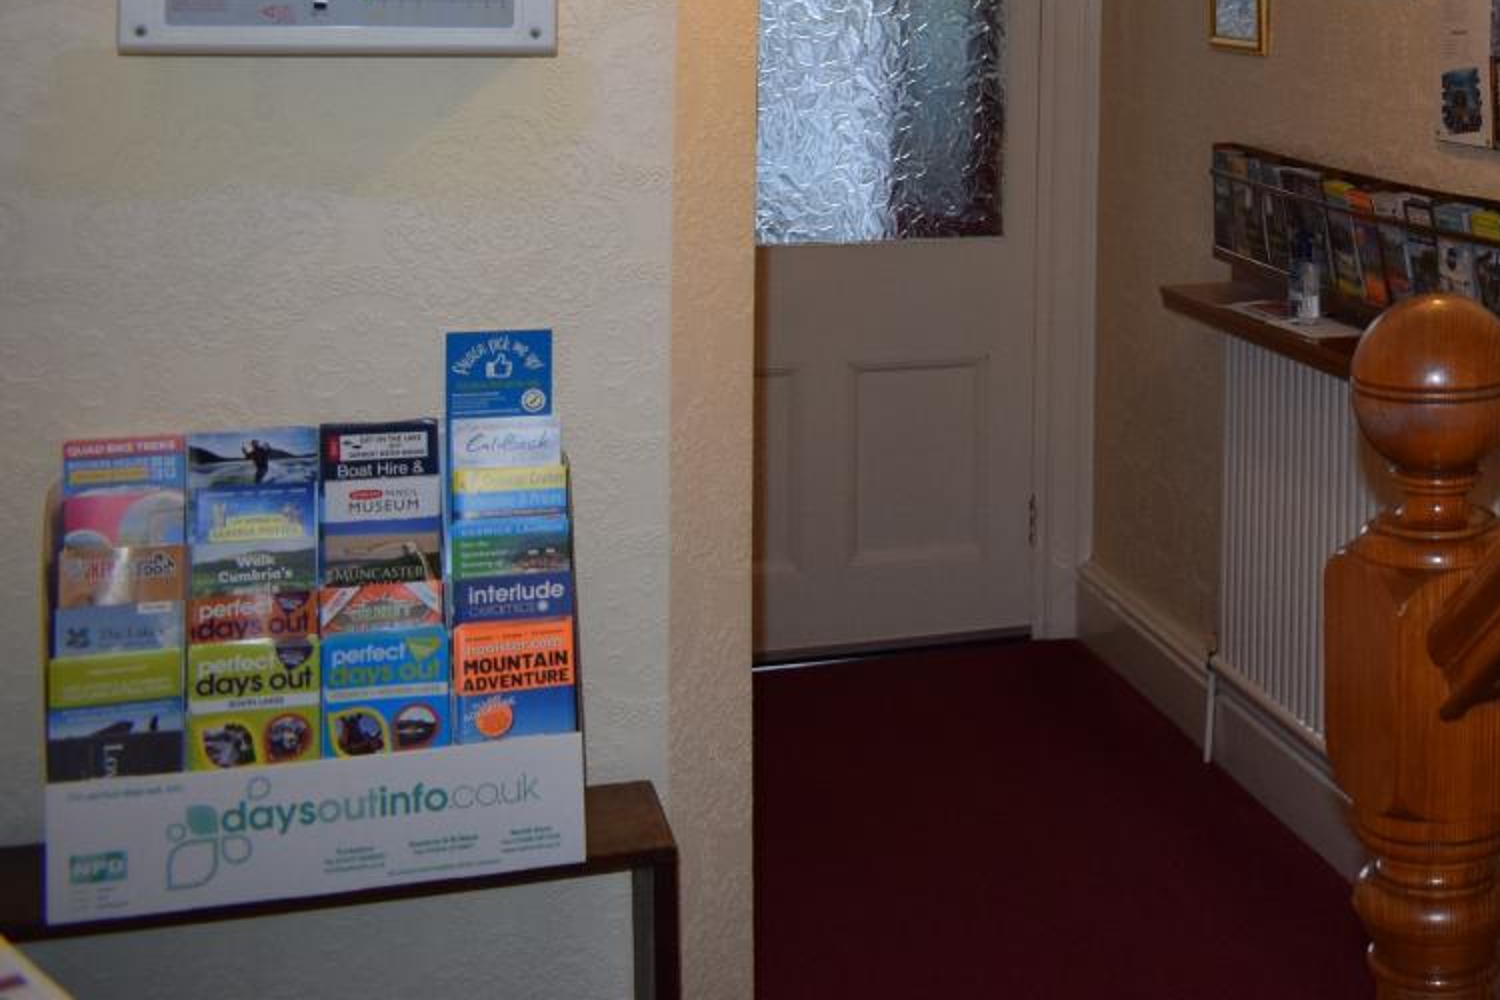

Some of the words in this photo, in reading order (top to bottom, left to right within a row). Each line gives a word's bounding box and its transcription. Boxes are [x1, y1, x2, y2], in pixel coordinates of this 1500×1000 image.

[337, 462, 373, 479] Boat
[377, 460, 408, 475] Hire
[412, 459, 424, 473] &
[349, 499, 420, 513] MUSEUM
[236, 553, 275, 567] Walk
[218, 566, 293, 582] Cumbria's
[335, 565, 424, 581] MUNCASTER
[469, 581, 565, 604] interlude
[198, 598, 273, 624] perfect
[197, 614, 262, 640] days
[269, 610, 308, 636] out
[197, 655, 274, 680] perfect
[331, 645, 406, 667] perfect
[463, 650, 568, 675] MOUNTAIN
[196, 672, 263, 697] days
[268, 665, 312, 691] out
[328, 664, 391, 686] days
[400, 658, 441, 680] out
[463, 668, 569, 693] ADVENTURE
[222, 773, 541, 836] daysoutinfo.co.uk
